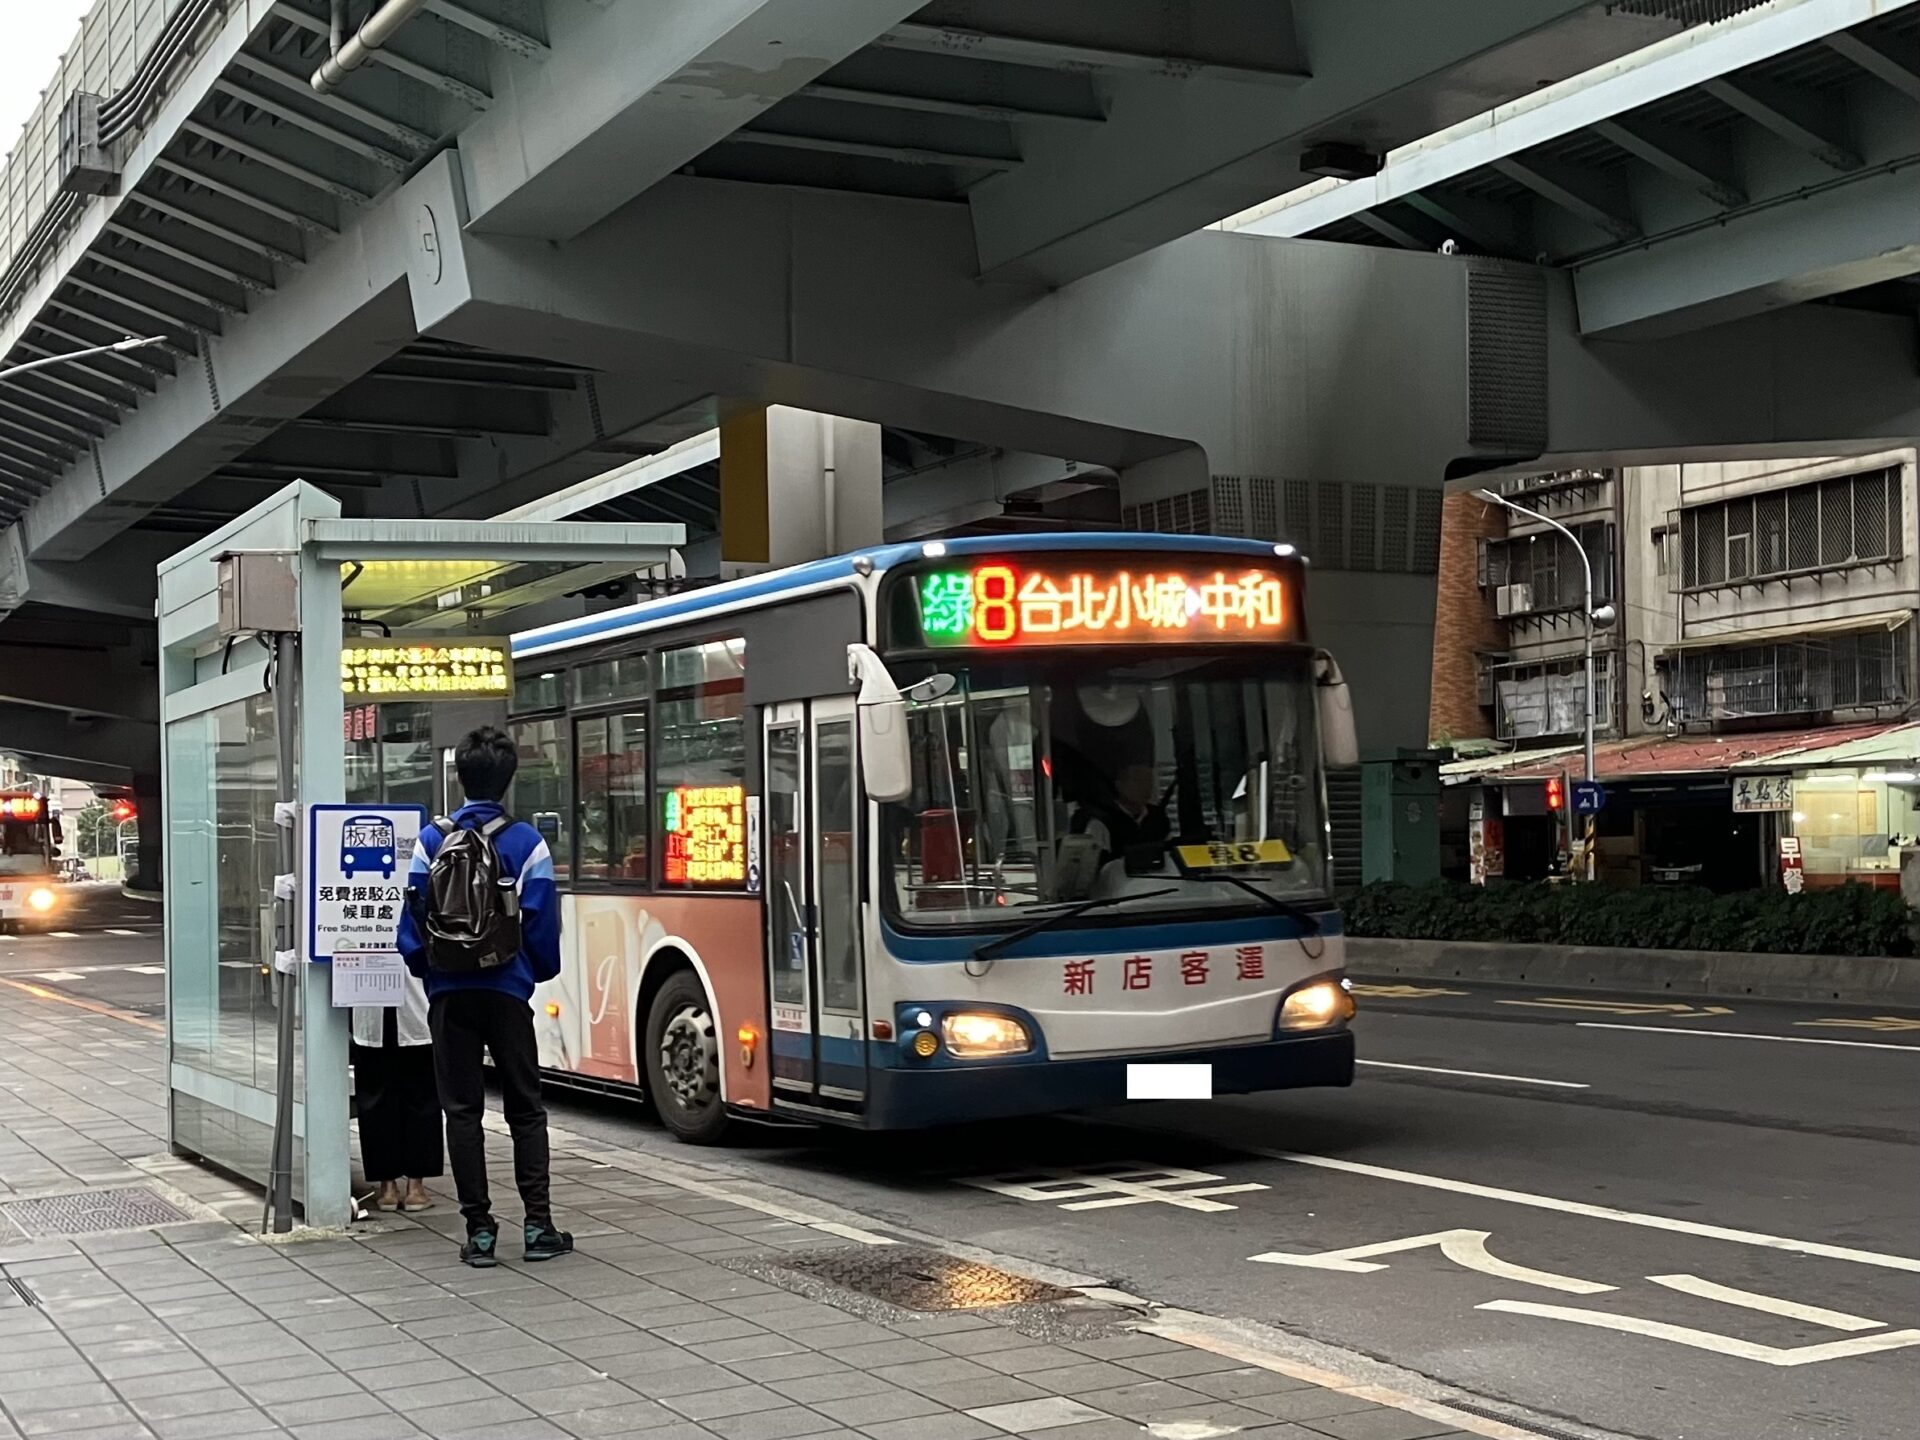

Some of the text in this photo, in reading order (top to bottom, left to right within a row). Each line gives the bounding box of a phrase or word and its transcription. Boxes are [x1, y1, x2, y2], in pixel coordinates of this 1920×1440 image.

[922, 566, 1282, 641] 綠8 台北小城 中和
[345, 826, 391, 848] 板橋
[1780, 837, 1805, 896] 早餐
[317, 924, 338, 933] Free
[340, 924, 373, 933] Shuttle
[375, 924, 393, 933] Bus
[342, 904, 393, 920] 候車處
[1063, 946, 1265, 996] 新店客運
